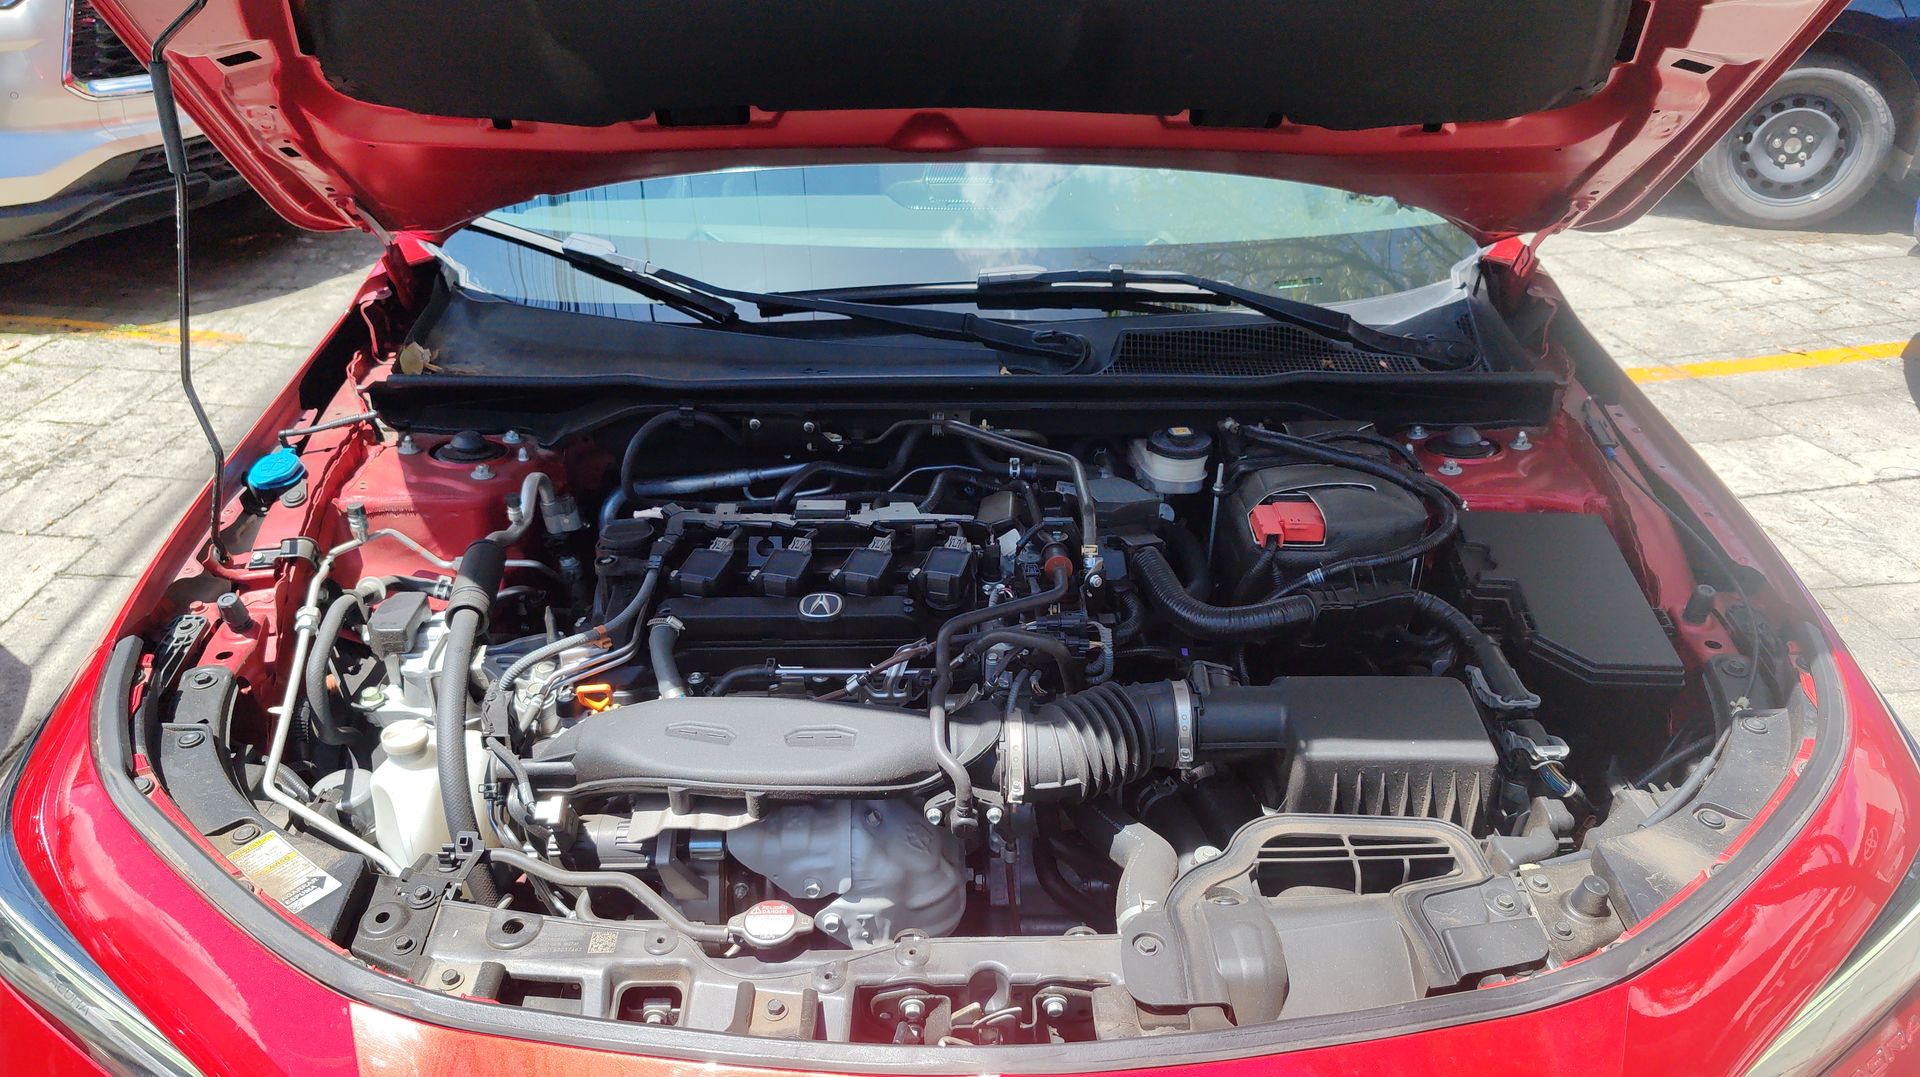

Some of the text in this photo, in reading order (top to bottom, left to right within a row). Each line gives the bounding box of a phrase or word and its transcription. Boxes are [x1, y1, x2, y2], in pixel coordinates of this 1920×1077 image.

[280, 877, 318, 901] AGARRAR
[284, 884, 317, 905] ESPUMA
[48, 977, 89, 1016] ACURA
